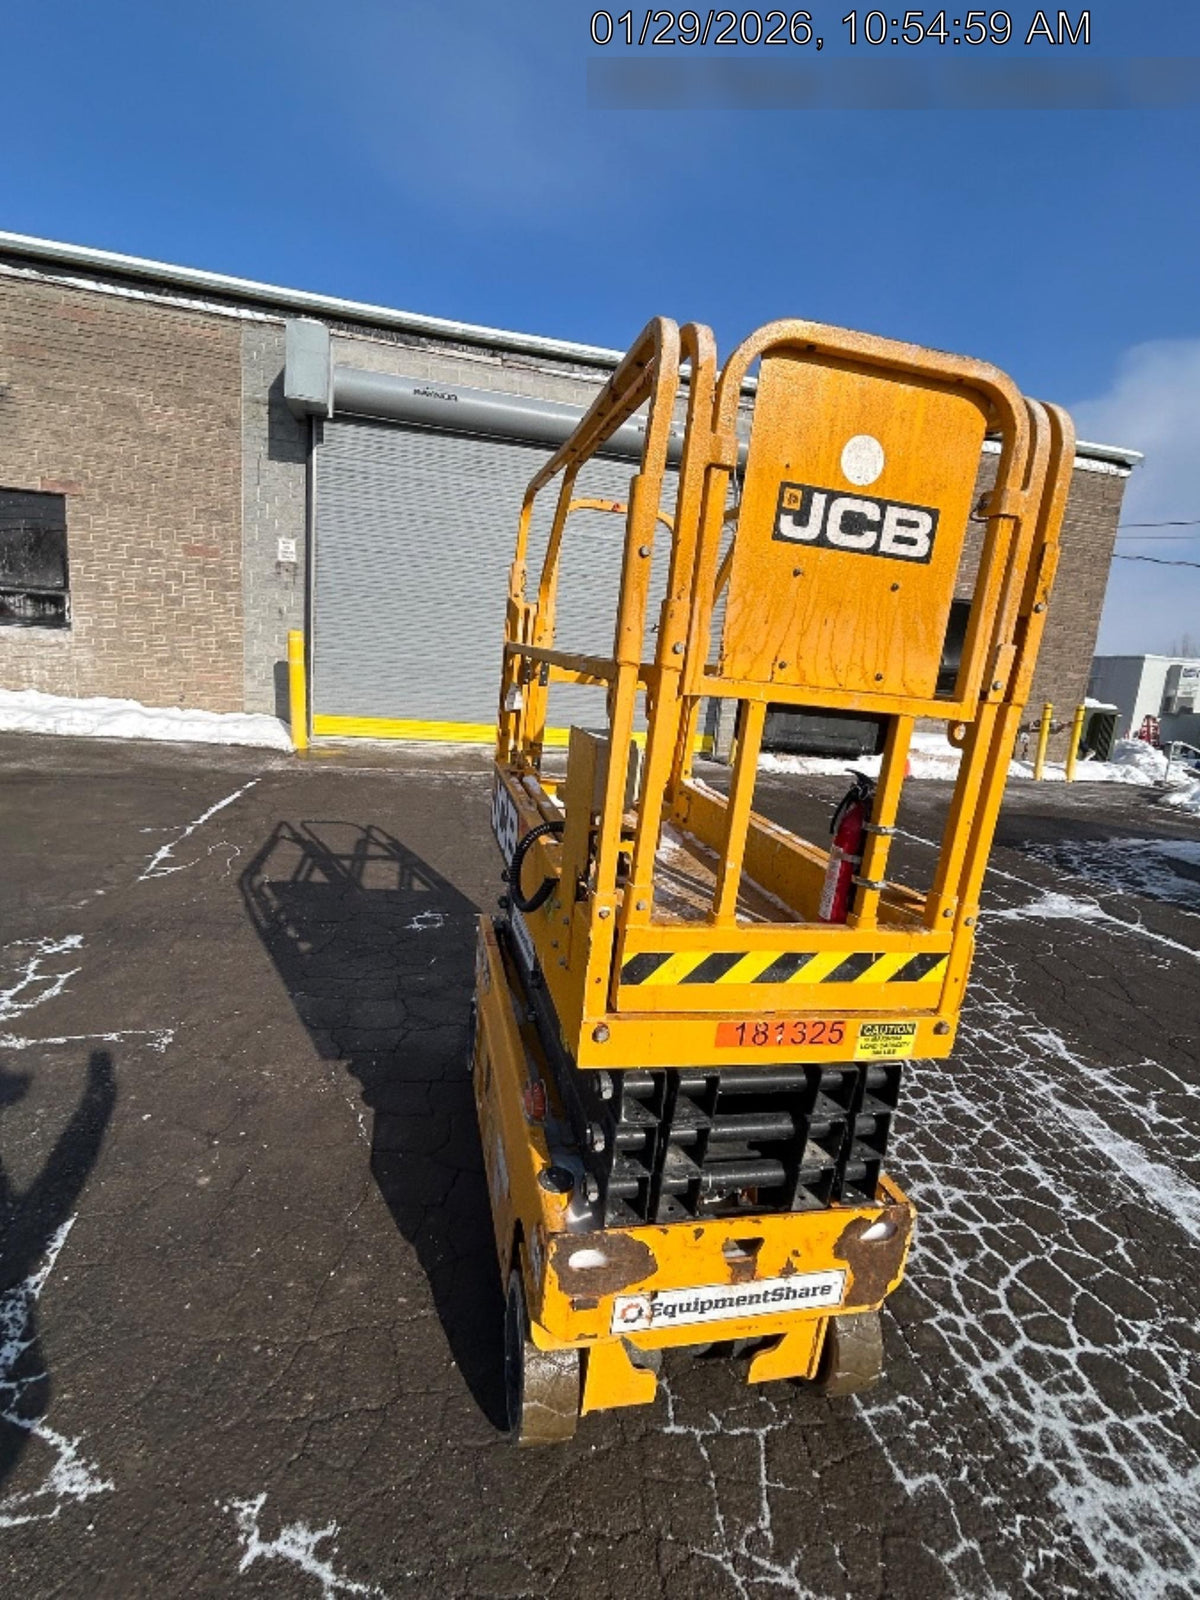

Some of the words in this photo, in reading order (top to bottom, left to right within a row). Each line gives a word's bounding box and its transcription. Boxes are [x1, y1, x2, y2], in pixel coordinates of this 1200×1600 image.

[779, 492, 933, 558] JCB
[735, 1020, 846, 1046] 181325
[863, 1025, 914, 1036] CAUTION
[650, 1285, 832, 1319] EquipmentShare
